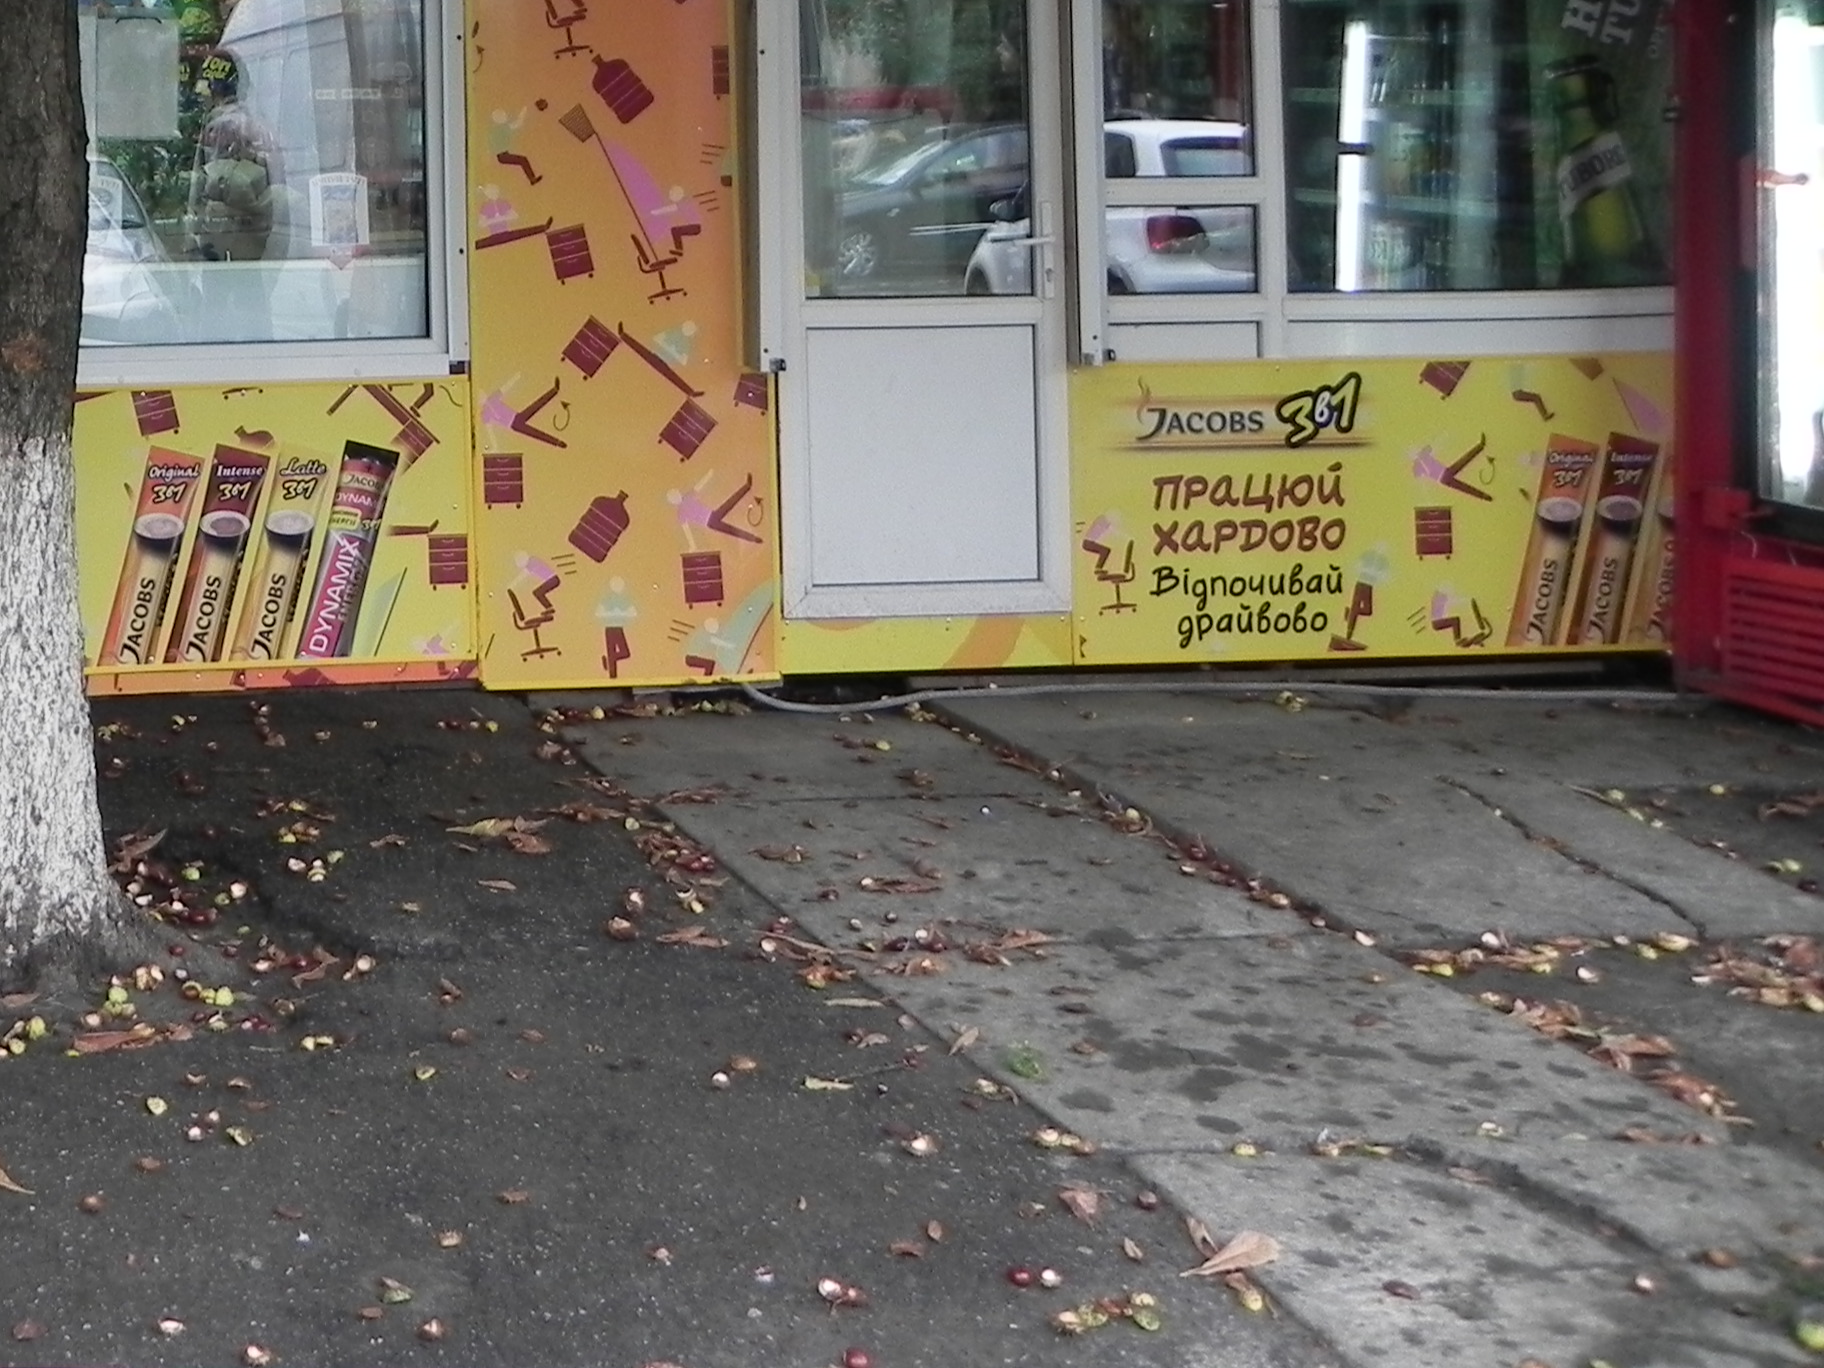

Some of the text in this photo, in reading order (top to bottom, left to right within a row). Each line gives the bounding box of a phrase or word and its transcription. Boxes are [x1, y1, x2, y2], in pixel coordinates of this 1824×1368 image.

[1135, 407, 1265, 441] JACOBS
[147, 463, 202, 483] Original
[215, 464, 265, 479] Intense
[278, 456, 328, 477] Latte
[1152, 461, 1346, 514] ПРАЦЮЙ
[1152, 515, 1347, 557] ХАРДОВО
[308, 536, 360, 652] DYNAMIX
[1148, 562, 1344, 612] Відпочивай
[1526, 558, 1559, 646] JACOBS
[1586, 556, 1618, 645] JACOBS
[118, 576, 157, 665] JACOBS
[185, 575, 223, 663] JACOBS
[250, 572, 288, 661] JACOBS
[1177, 600, 1329, 650] драйвово
